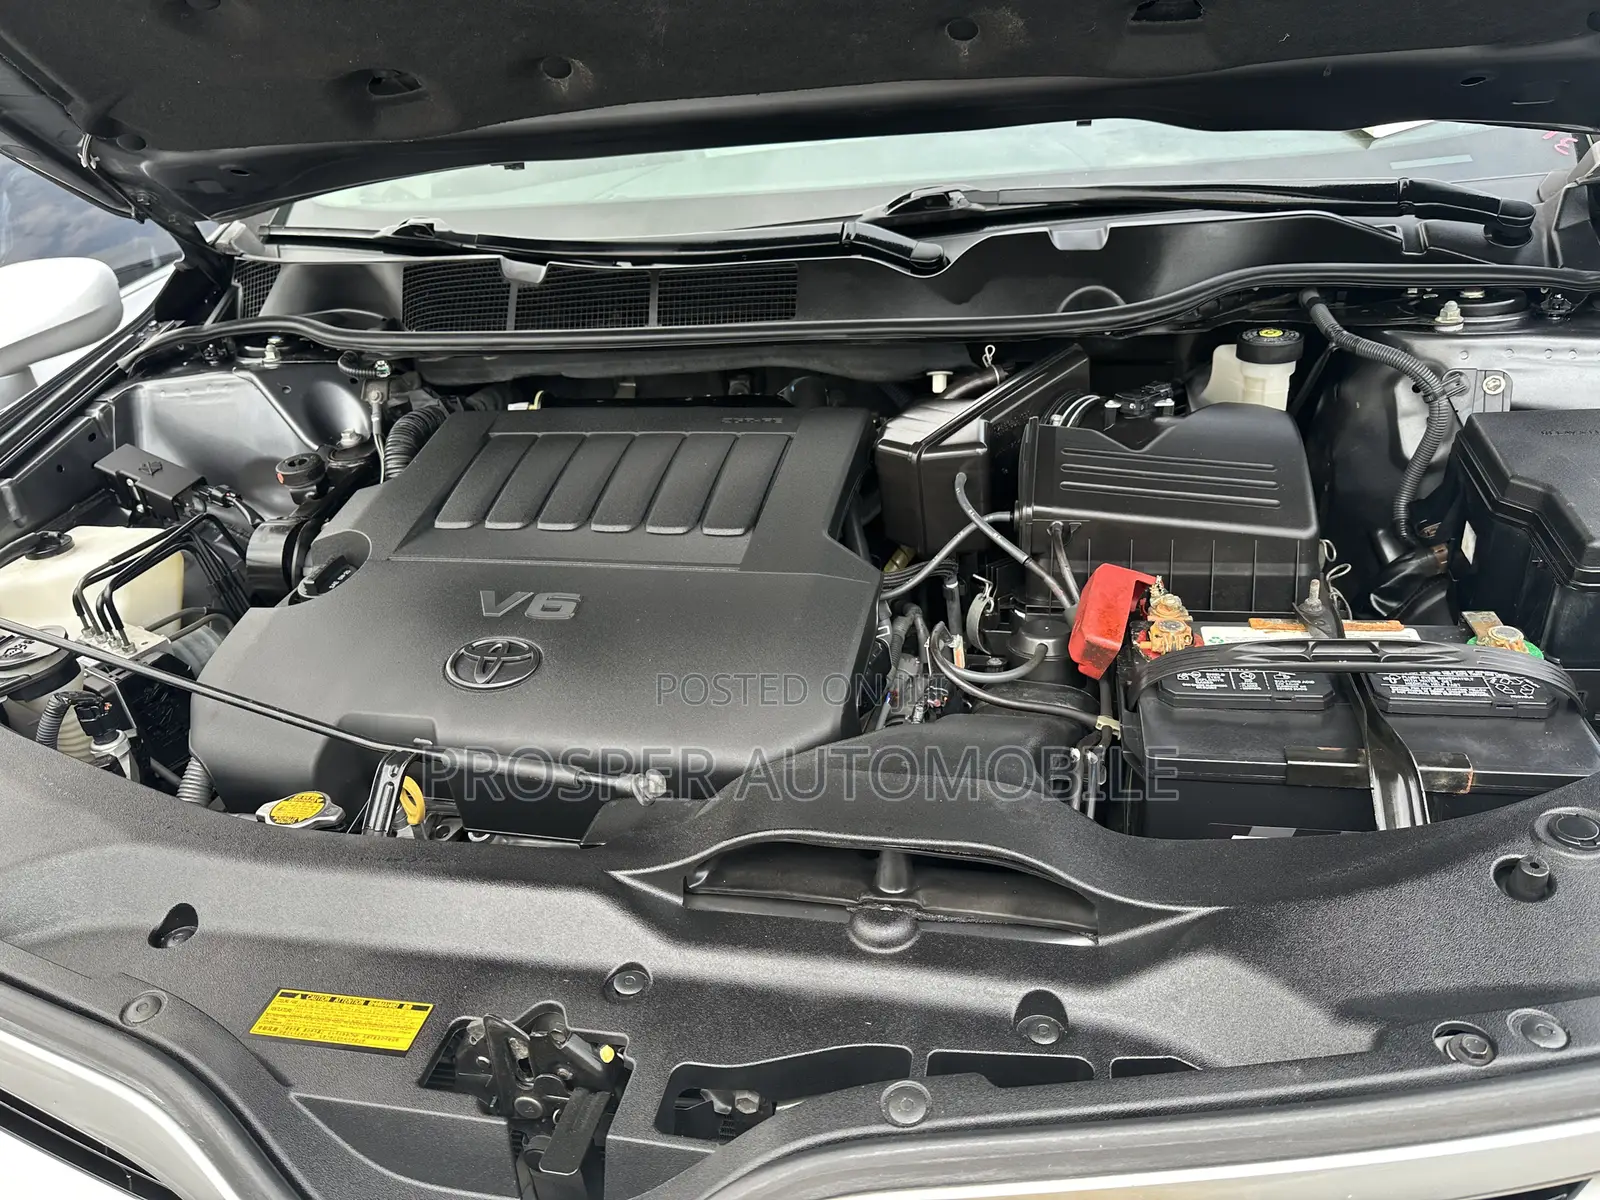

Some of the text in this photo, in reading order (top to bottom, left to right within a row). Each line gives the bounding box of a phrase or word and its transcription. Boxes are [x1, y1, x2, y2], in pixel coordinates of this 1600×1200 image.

[480, 590, 582, 620] V6
[306, 993, 331, 1002] CAUTION
[334, 997, 364, 1006] ATTENTION
